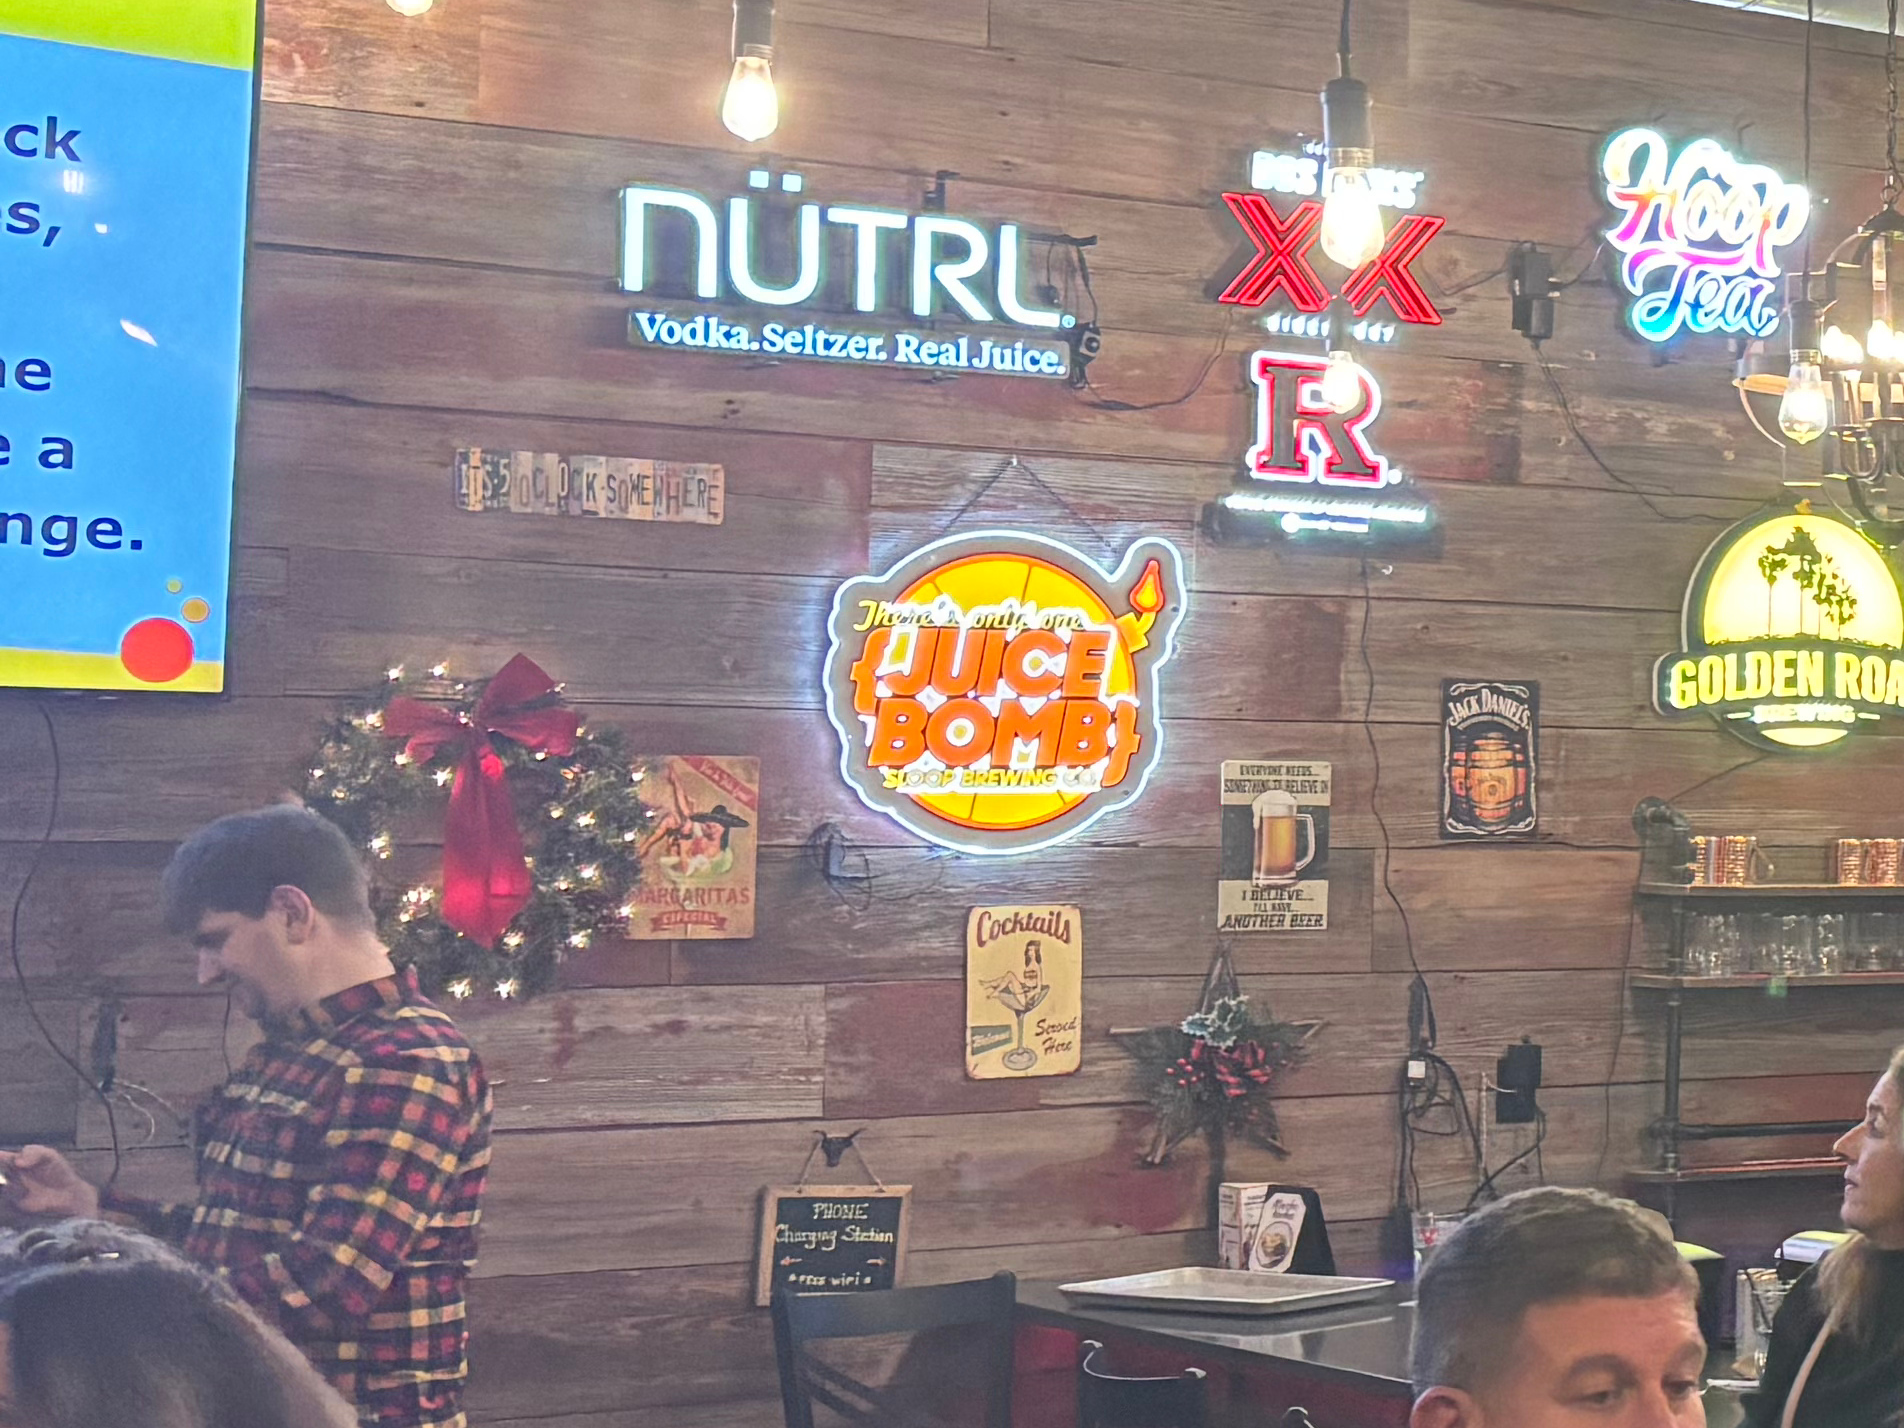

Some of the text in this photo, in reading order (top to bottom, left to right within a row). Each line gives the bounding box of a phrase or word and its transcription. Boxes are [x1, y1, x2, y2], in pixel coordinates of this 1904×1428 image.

[1602, 128, 1809, 274] Hoop
[0, 202, 61, 247] s,
[1625, 247, 1779, 341] Tea
[635, 312, 1068, 375] Vodka. Seltzer. Real Juice.
[880, 628, 1112, 698] JUICE
[1670, 650, 1825, 709] GOLDEN
[1448, 695, 1480, 726] JACK
[867, 698, 1113, 767] BOMB
[960, 769, 1057, 788] BREWING
[977, 910, 1072, 949] Cocktails
[1220, 913, 1325, 929] ANOTHER BEER
[1034, 1017, 1079, 1038] Served
[1041, 1036, 1074, 1057] Here
[813, 1202, 869, 1220] PHONE
[775, 1223, 895, 1251] Charging Station
